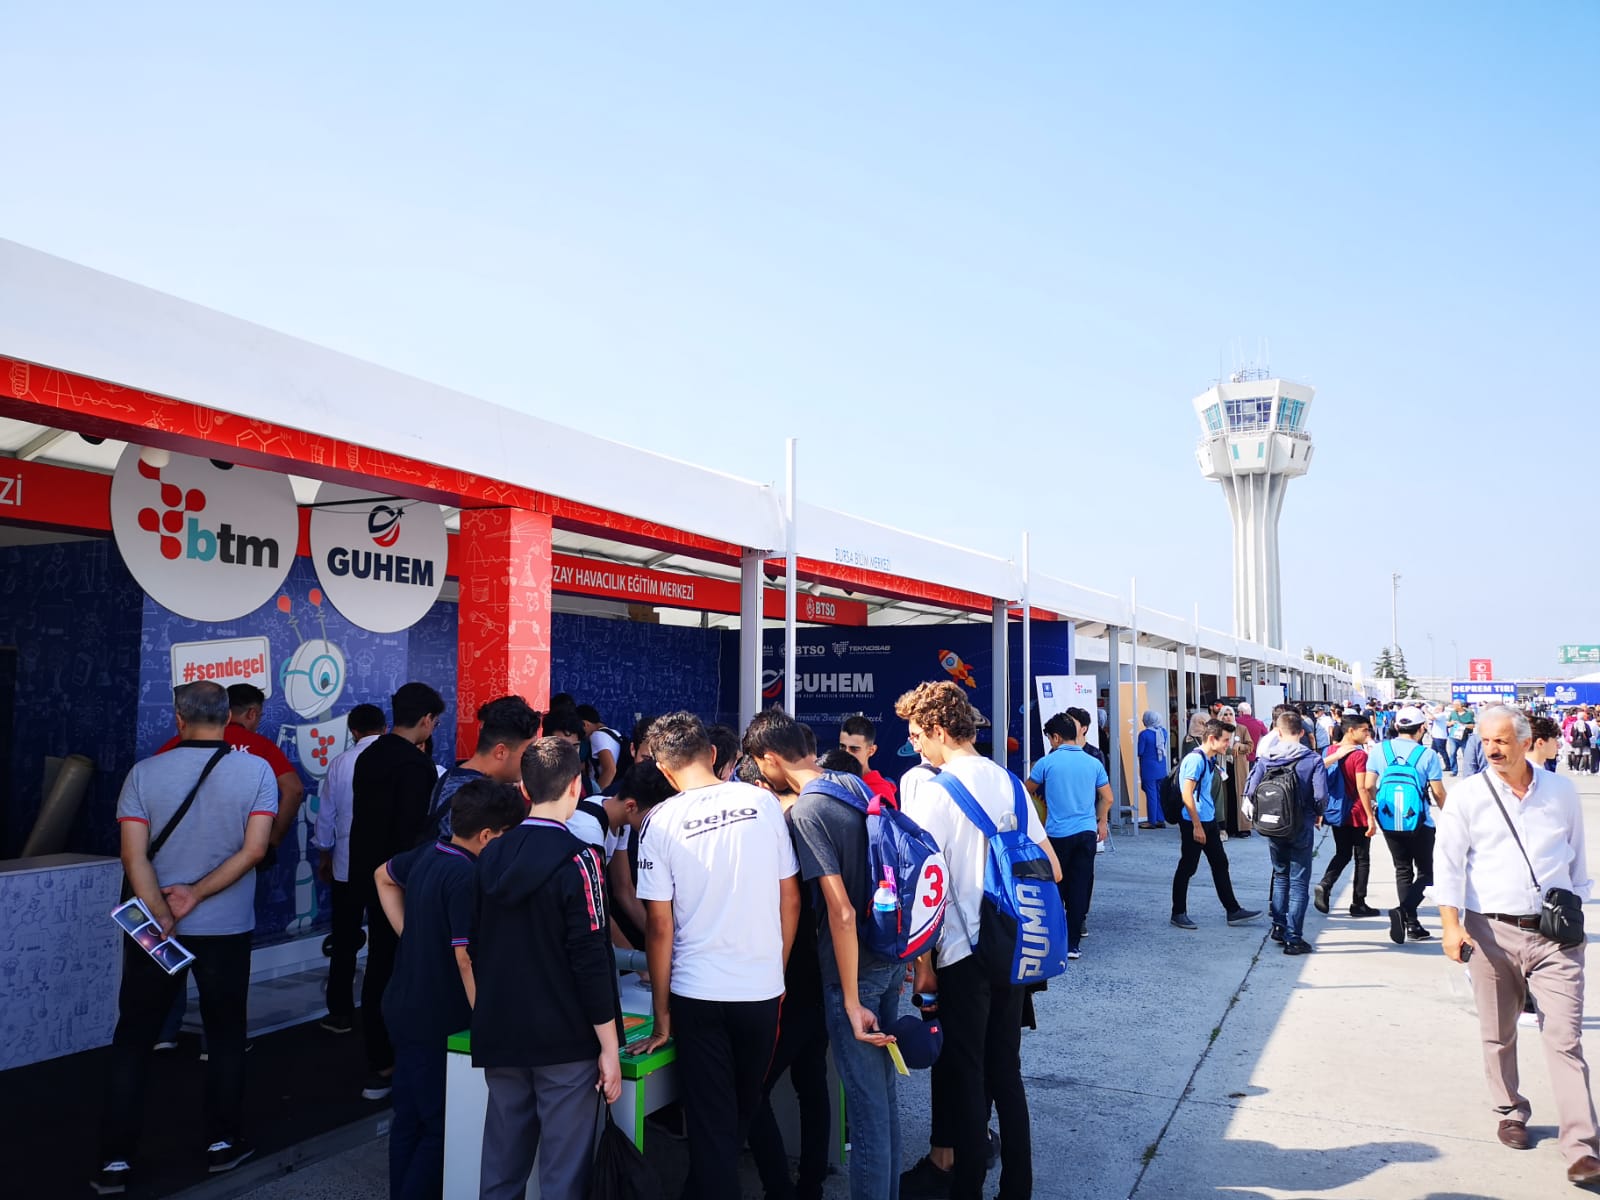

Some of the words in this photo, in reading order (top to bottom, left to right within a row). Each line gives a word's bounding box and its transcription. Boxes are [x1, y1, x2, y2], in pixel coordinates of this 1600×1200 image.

[186, 517, 279, 568] btm
[327, 546, 434, 587] GUHEM
[551, 564, 574, 585] ZAY
[575, 568, 626, 592] HAVACILIK
[627, 574, 658, 596] EĞİTİM
[660, 581, 694, 601] MERKEZİ
[815, 601, 836, 616] BTSO
[183, 653, 265, 682] #sendegel
[795, 645, 826, 655] BTSO
[682, 807, 758, 831] beko
[922, 864, 944, 908] 3
[1016, 883, 1051, 981] PUMA
